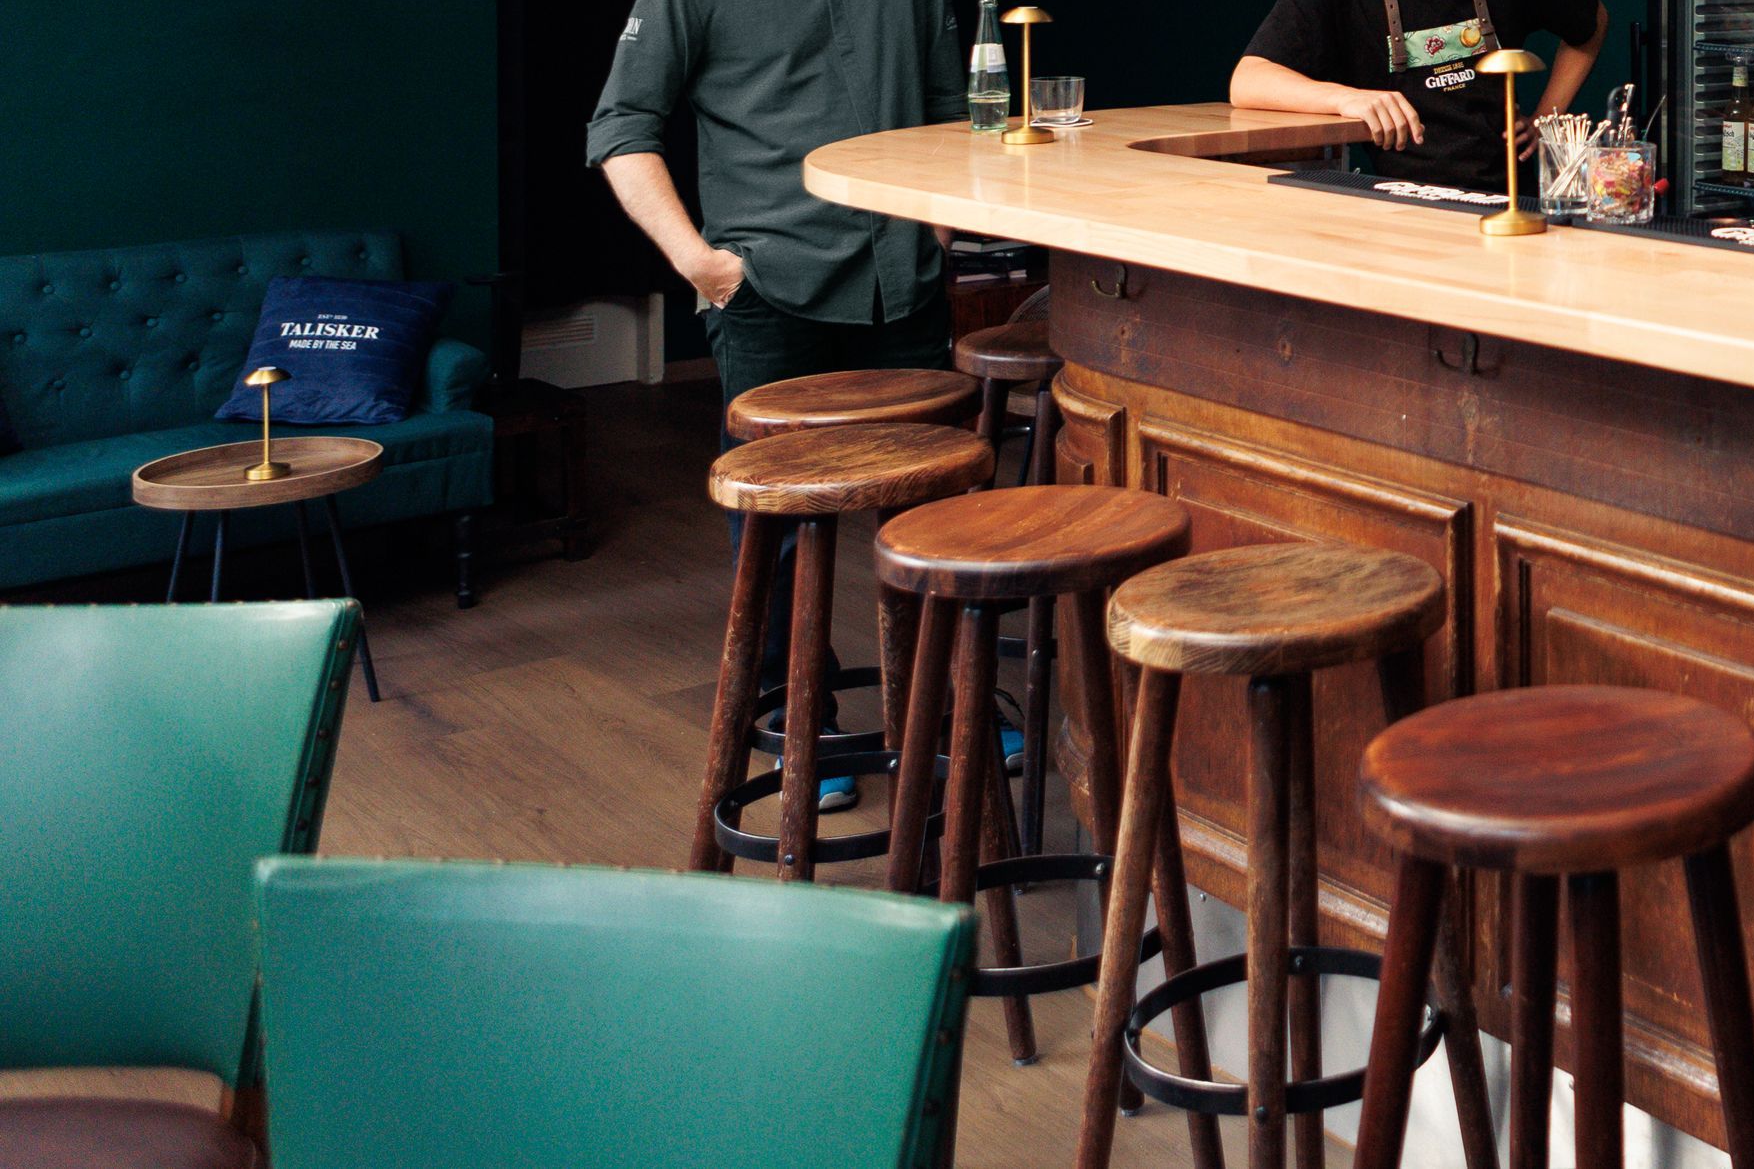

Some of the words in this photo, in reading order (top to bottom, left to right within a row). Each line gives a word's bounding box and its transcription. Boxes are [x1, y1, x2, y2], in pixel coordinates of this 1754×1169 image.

[1425, 68, 1476, 89] GIFFARD
[280, 322, 380, 339] TALISKER
[289, 339, 312, 349] MADE
[312, 340, 325, 349] BY
[326, 340, 341, 349] THE
[341, 340, 357, 350] SEA
